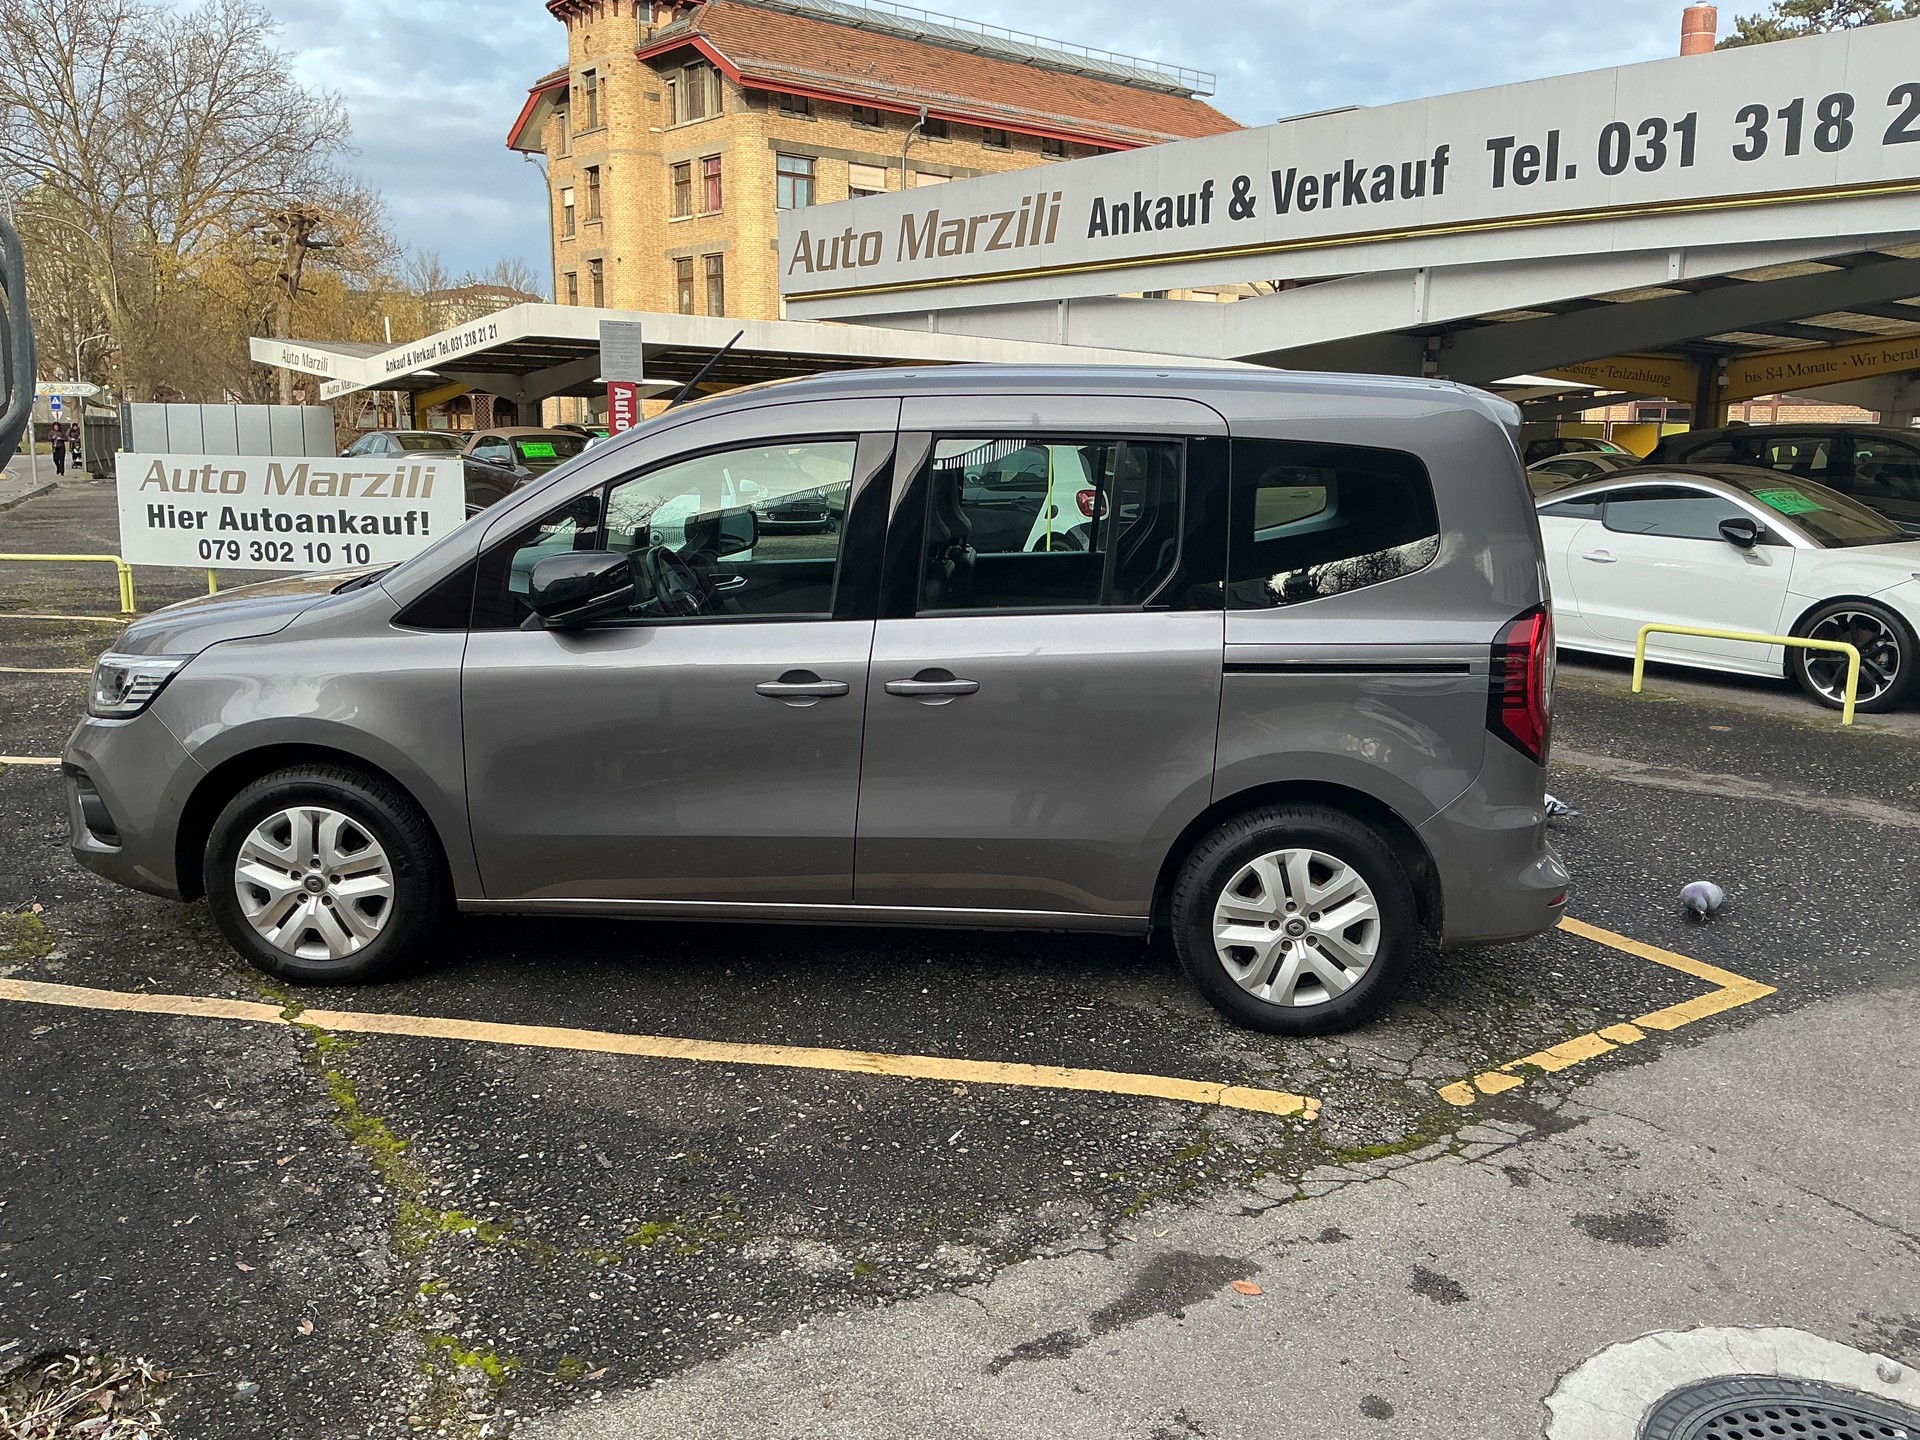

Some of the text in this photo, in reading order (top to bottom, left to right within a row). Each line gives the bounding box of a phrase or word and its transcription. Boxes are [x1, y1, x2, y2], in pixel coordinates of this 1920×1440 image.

[788, 227, 883, 276] Auto
[897, 191, 1063, 262] Marzili
[1087, 180, 1215, 239] Ankauf
[1228, 174, 1257, 221] &
[1271, 144, 1450, 215] Verkauf
[1486, 129, 1577, 189] Tel.
[1598, 111, 1698, 176] 031
[1732, 92, 1856, 162] 318
[281, 349, 329, 372] Auto Marzili
[385, 323, 498, 374] Ankauf & Verkauf Tel. 031 318 21 21
[1606, 365, 1671, 387] Teilzahlung
[1744, 371, 1763, 383] bis
[1765, 366, 1784, 381] 84
[1787, 361, 1838, 378] Monate
[1850, 353, 1878, 368] Wir
[326, 383, 340, 395] Auto
[614, 387, 632, 431] Auto
[139, 459, 437, 498] Auto Marzili
[147, 503, 430, 536] Hier Autoankauf!
[199, 539, 371, 564] 079 302 10 10
